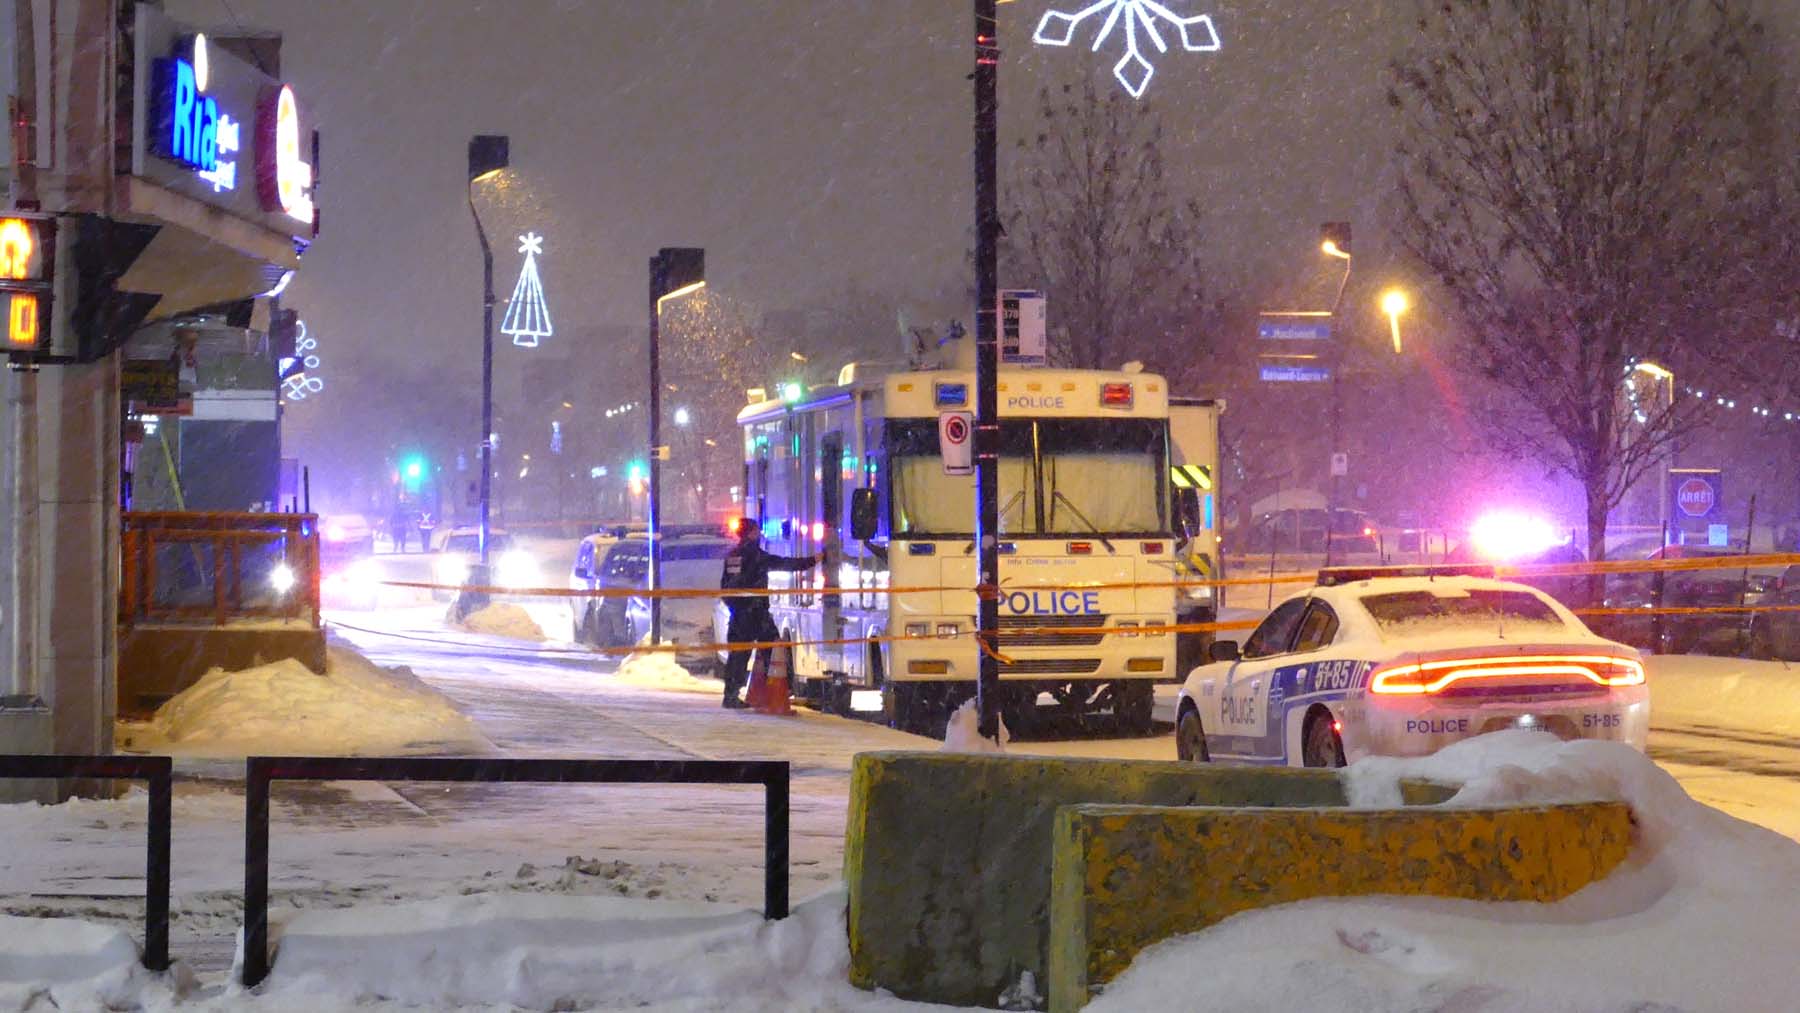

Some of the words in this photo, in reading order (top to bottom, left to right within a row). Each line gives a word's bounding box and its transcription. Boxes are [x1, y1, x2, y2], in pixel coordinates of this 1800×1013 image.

[172, 57, 218, 172] Ria
[1007, 396, 1065, 409] POLICE
[1315, 660, 1351, 690] 51-85
[1220, 695, 1256, 725] POLICE
[1583, 713, 1621, 728] 51-85
[1406, 719, 1469, 734] POLICE
